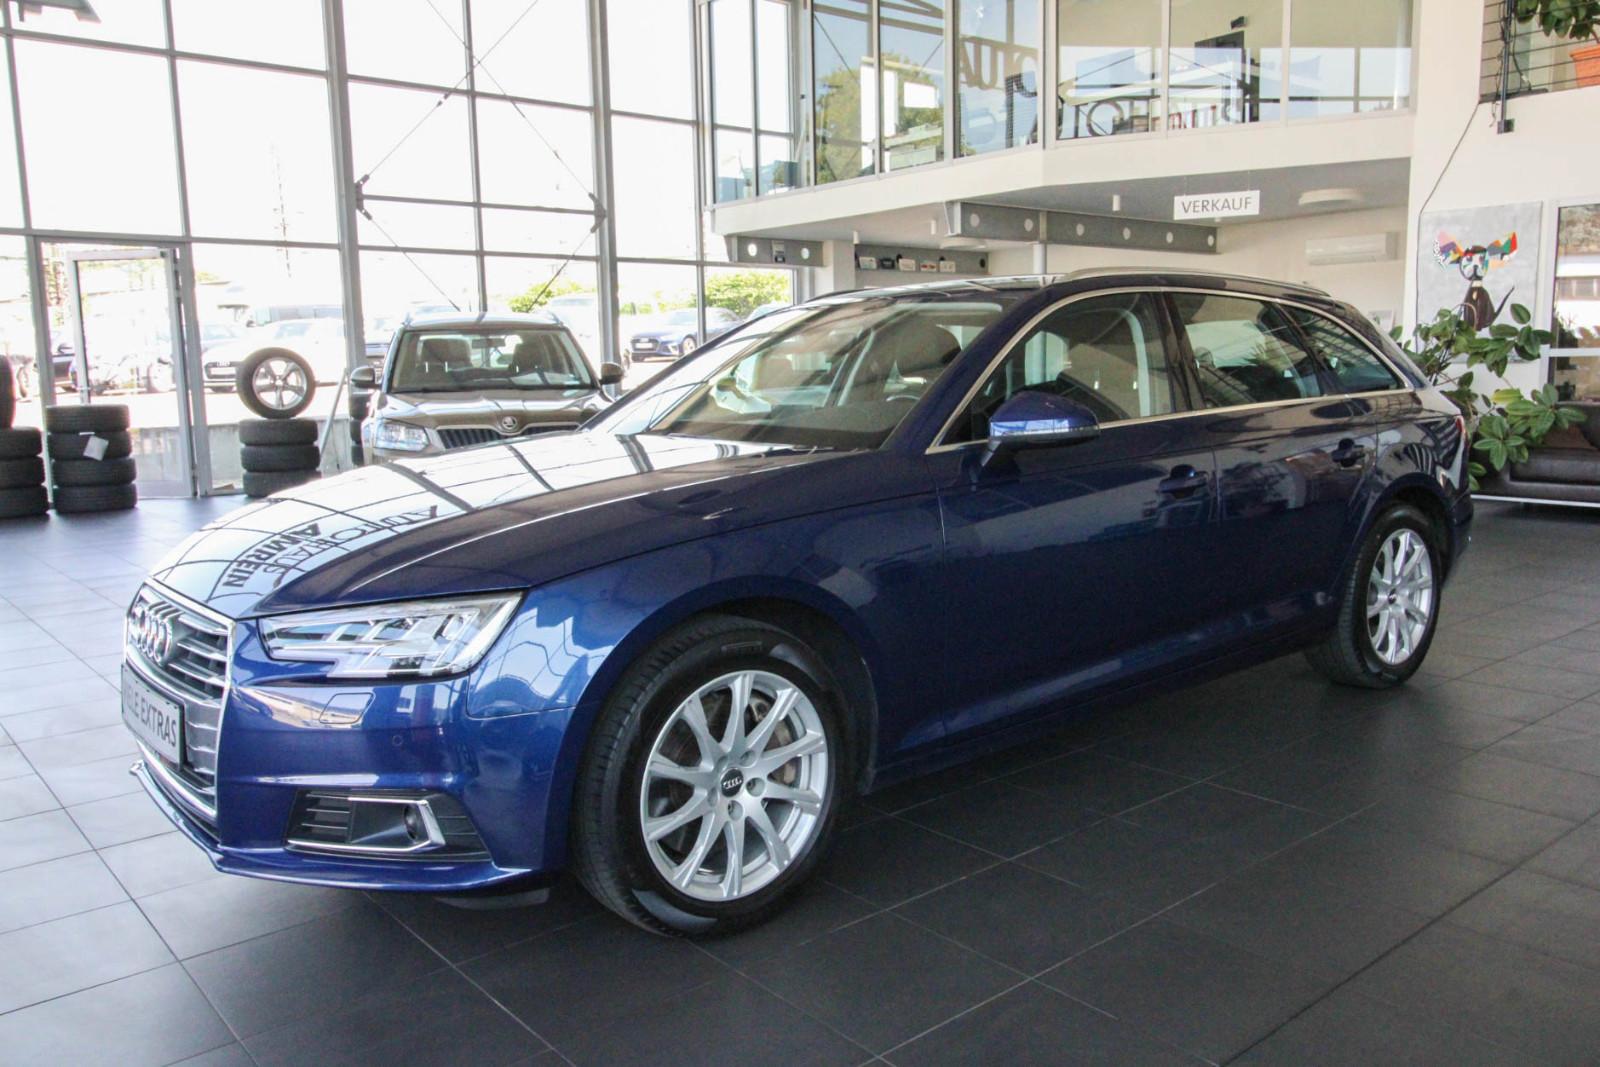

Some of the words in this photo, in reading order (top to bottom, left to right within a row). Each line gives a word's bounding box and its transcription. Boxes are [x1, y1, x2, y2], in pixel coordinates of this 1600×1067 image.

[1181, 197, 1252, 214] VERKAUF
[222, 522, 321, 588] AMREIN
[141, 697, 177, 748] EXTRAS
